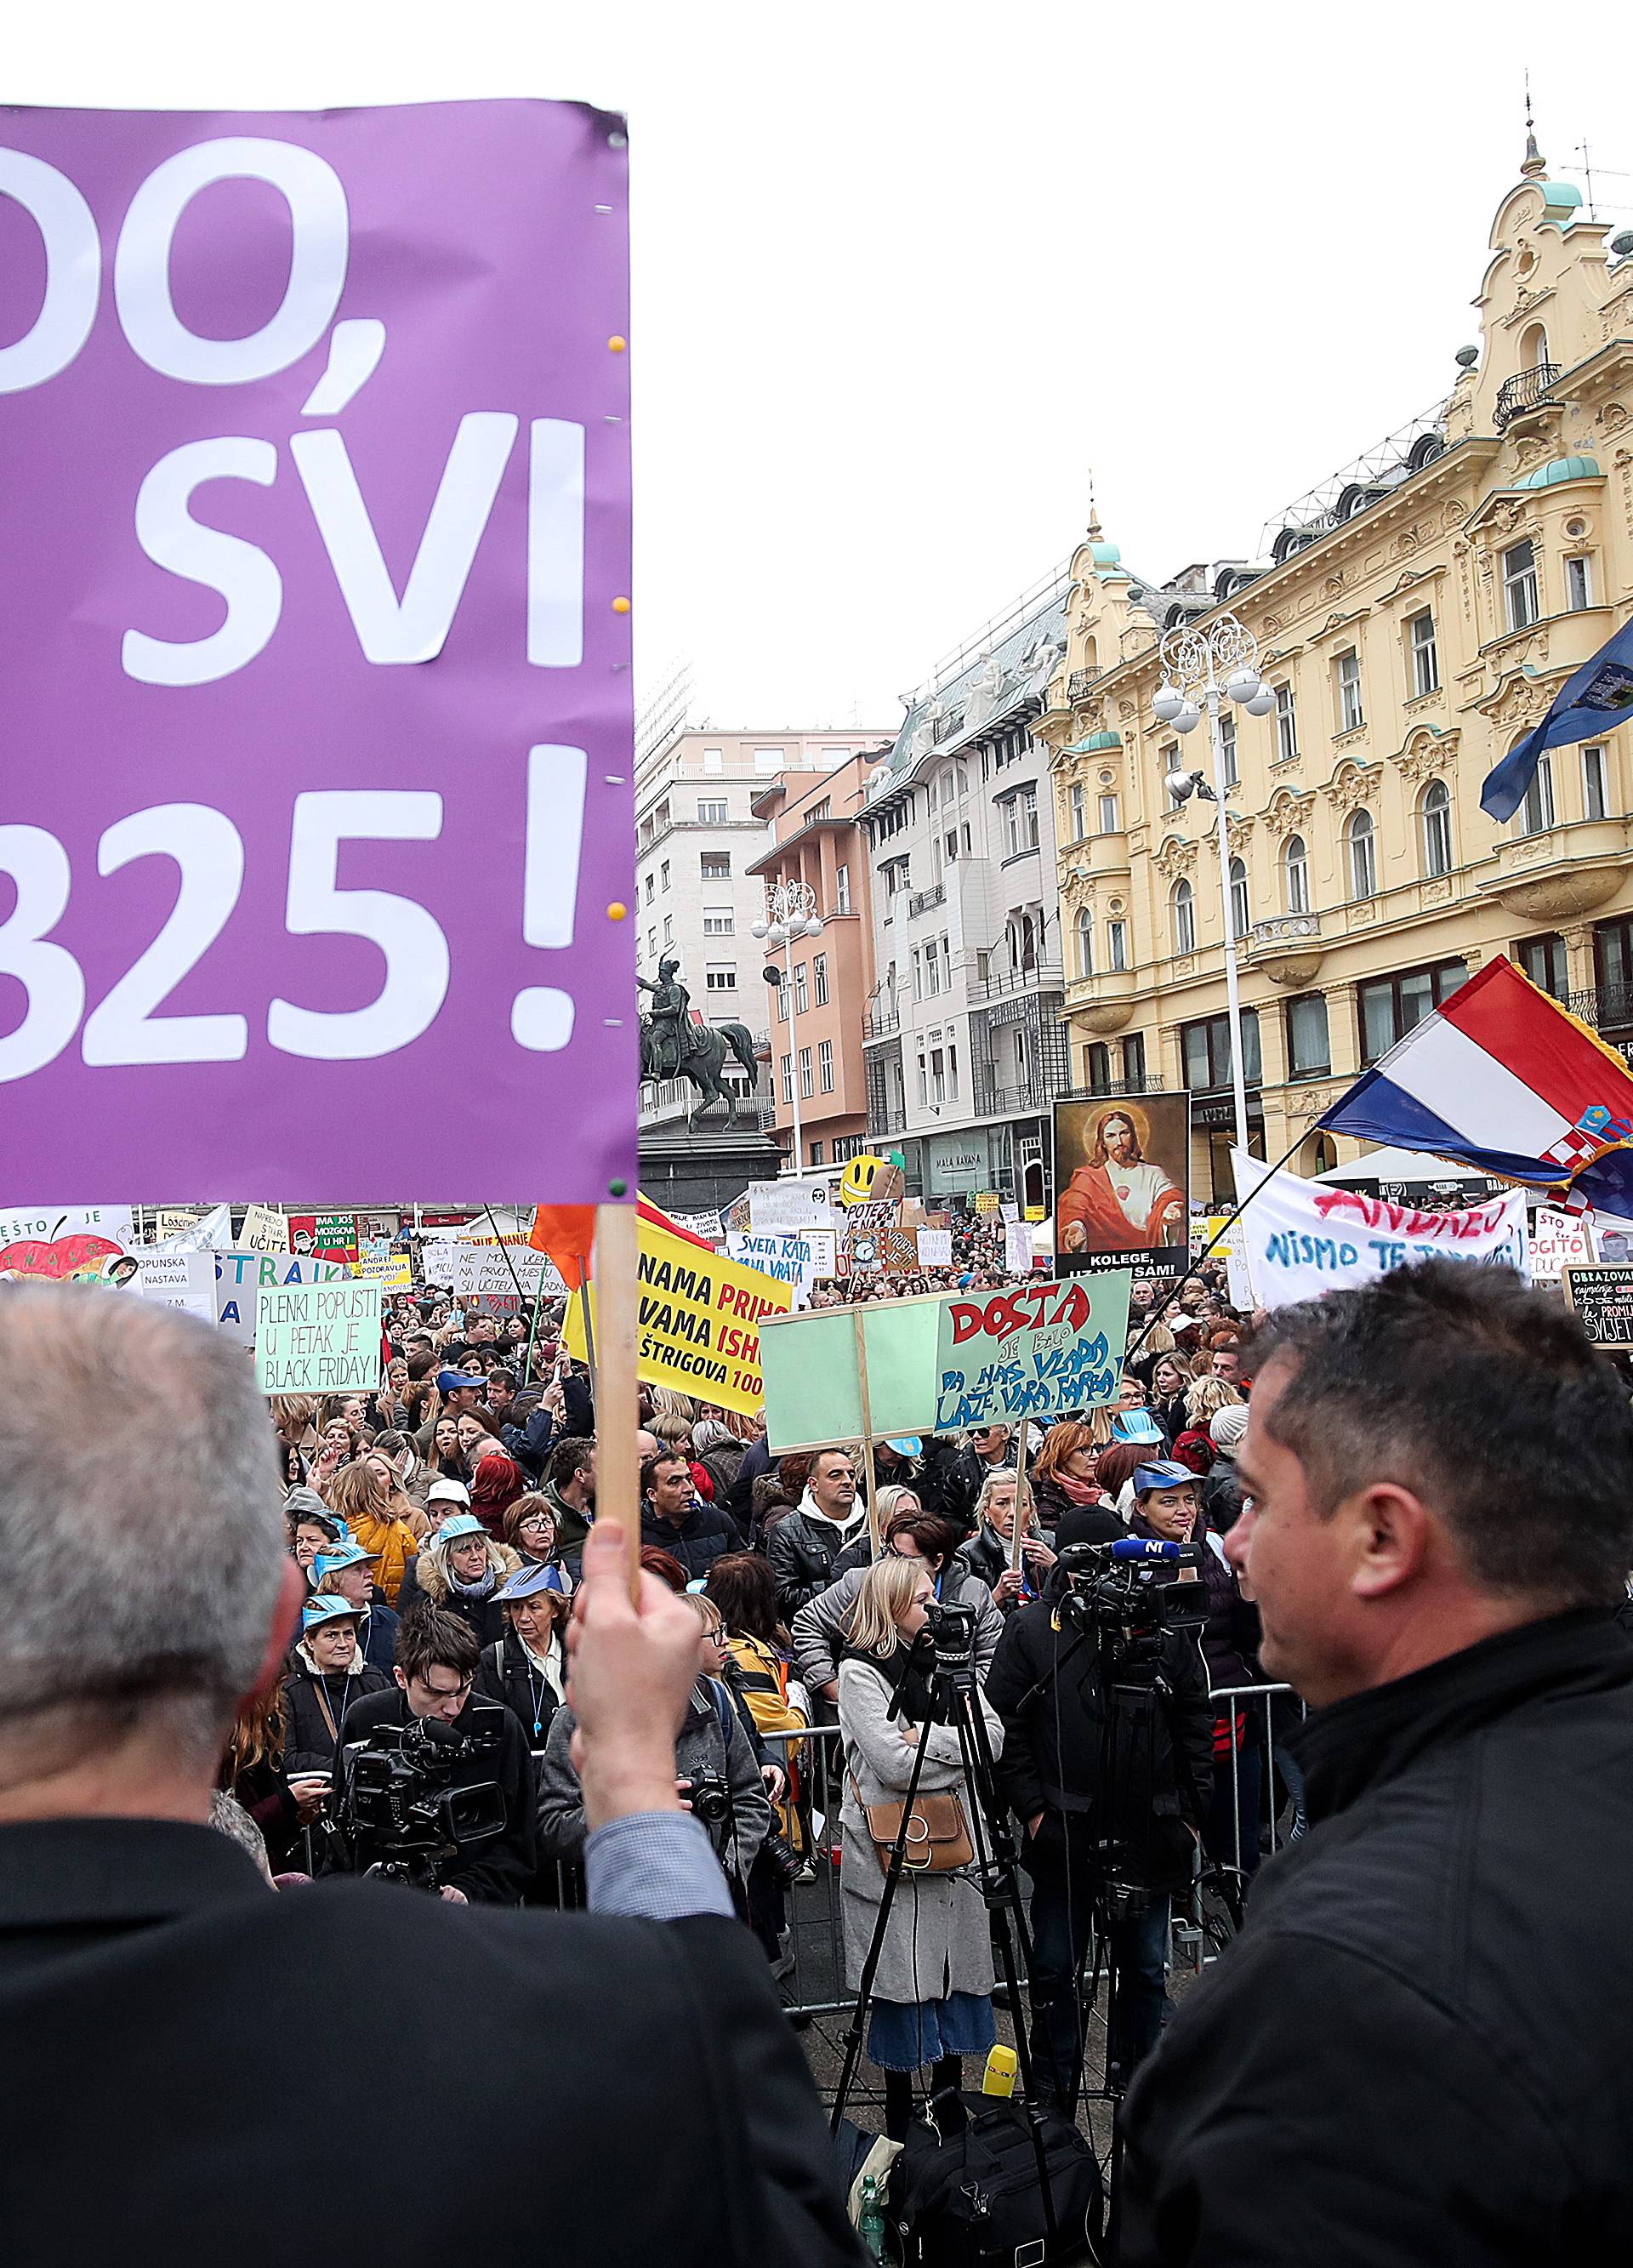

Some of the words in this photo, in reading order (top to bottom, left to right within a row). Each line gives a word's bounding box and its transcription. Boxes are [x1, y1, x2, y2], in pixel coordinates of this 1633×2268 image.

[121, 411, 586, 687] SVI
[85, 1211, 101, 1224] JE
[316, 1217, 334, 1225] IMA
[337, 1215, 354, 1225] JOŠ
[1539, 1212, 1564, 1229] ŠTO
[315, 1226, 356, 1236] MOZGOVA
[323, 1238, 331, 1246] U
[737, 1235, 777, 1256] SVETA
[781, 1239, 811, 1262] KATA
[459, 1253, 477, 1264] NE
[1090, 1252, 1155, 1267] KOLEGE,
[145, 1275, 187, 1285] NASTAVA
[459, 1267, 474, 1276] NA
[638, 1253, 711, 1305] NAMA
[770, 1260, 803, 1283] VRATA
[1134, 1265, 1175, 1278] SAM!
[460, 1280, 474, 1292] SU
[316, 1289, 378, 1320] POPUSTI
[948, 1283, 1091, 1346] DOSTA
[265, 1329, 277, 1356] U
[290, 1324, 334, 1354] PETAK
[341, 1323, 360, 1354] JE
[638, 1296, 711, 1348] VAMA
[716, 1325, 763, 1367] ISH
[640, 1333, 728, 1384] ŠTRIGOVA
[265, 1359, 312, 1388] BLACK
[317, 1354, 377, 1386] FRIDAY!
[976, 1361, 1027, 1386] NAS
